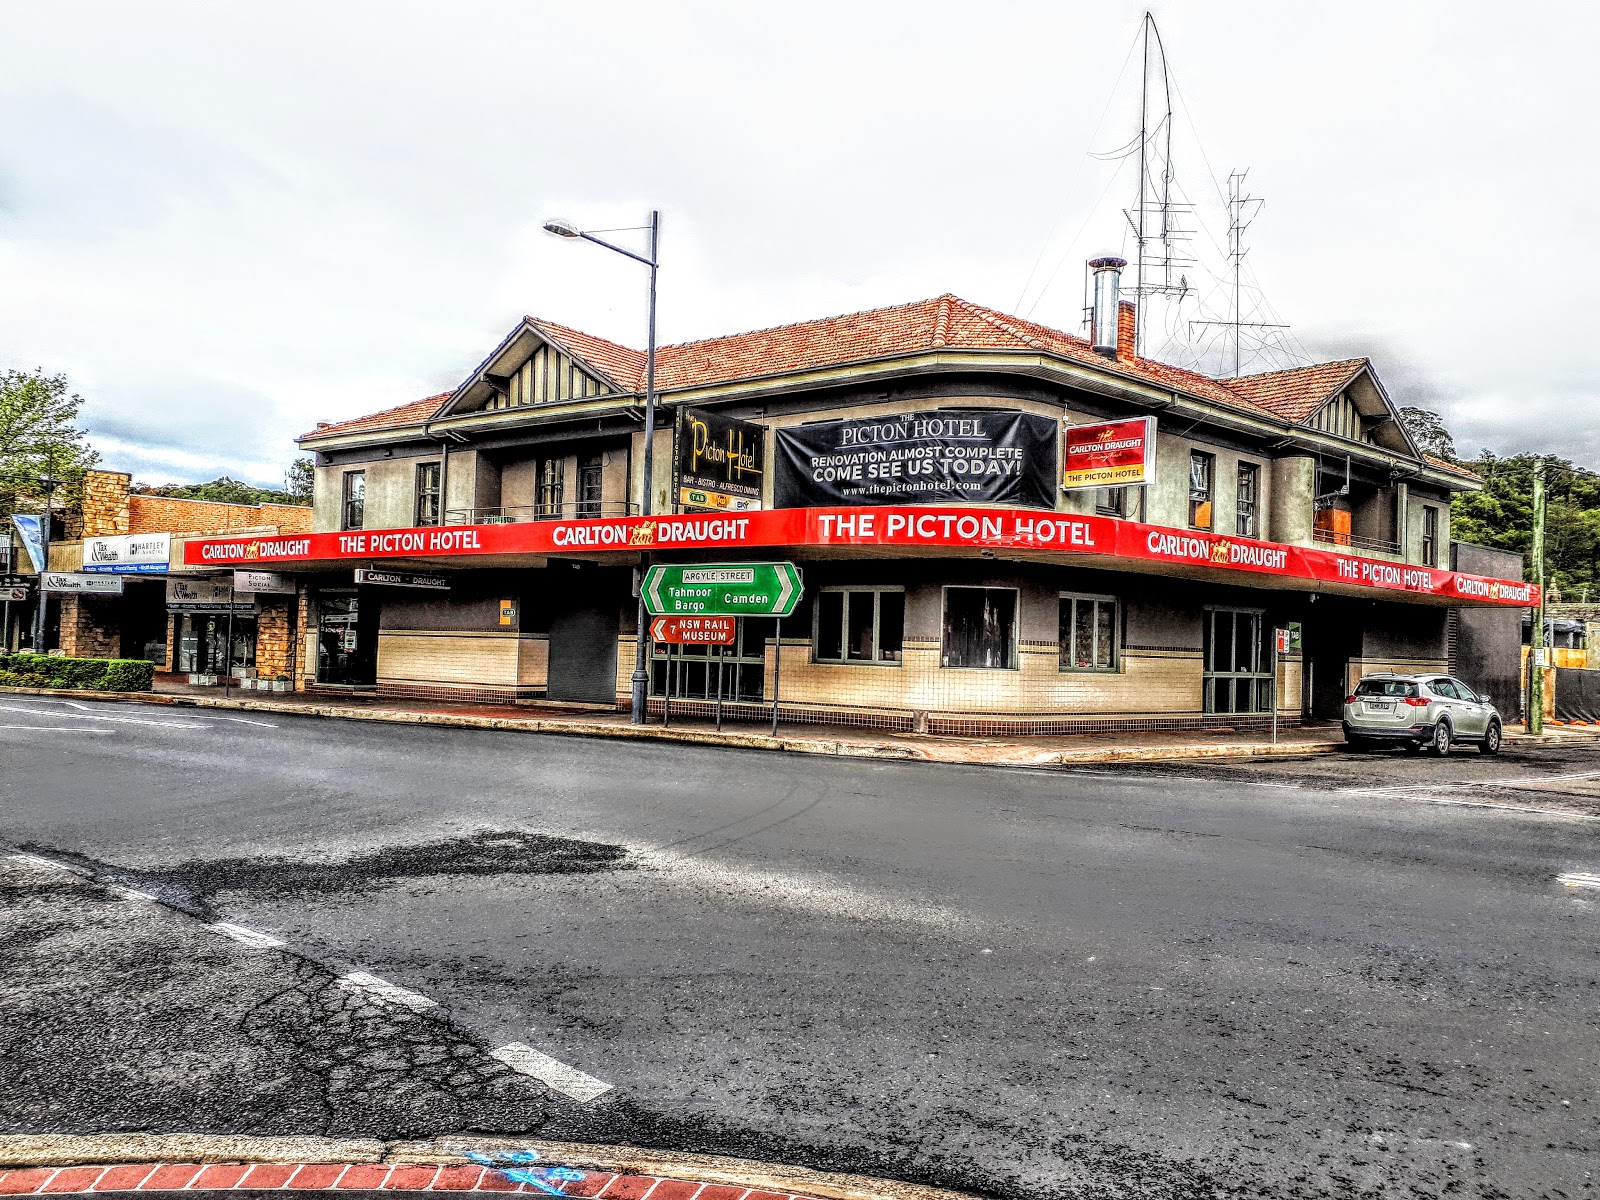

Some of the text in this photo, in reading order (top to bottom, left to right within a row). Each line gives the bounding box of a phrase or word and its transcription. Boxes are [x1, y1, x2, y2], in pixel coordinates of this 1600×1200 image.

[841, 419, 986, 445] PICTON HOTEL
[692, 418, 755, 480] Picton Hotel
[1069, 439, 1142, 454] CARLTON DRAUGHT
[811, 447, 1023, 467] RENOVATION ALMOST COMPLETE
[813, 458, 1021, 482] COME SEE US TODAY!
[1085, 472, 1112, 480] PICTON
[1115, 469, 1140, 478] HOTEL
[683, 475, 694, 484] BAR
[698, 478, 716, 488] BISTRO
[719, 482, 743, 492] ALFRESCO
[743, 486, 760, 495] DINING
[843, 480, 981, 495] www.thepictonhotel.com
[552, 519, 749, 546] CARLTON DRAUGHT
[818, 514, 1095, 546] THE PICTON HOTEL
[96, 541, 107, 551] Tax
[202, 539, 310, 559] CARLTON DRAUGHT
[338, 530, 481, 553] THE PICTON HOTEL
[98, 551, 118, 561] Wealth
[1147, 531, 1287, 569] CARLTON DRAUGHT
[367, 573, 401, 583] CARLTON
[413, 577, 446, 586] DRAUGHT
[684, 571, 751, 581] ARGYLE STREET
[1337, 558, 1434, 589] THE PICTON HOTEL
[177, 582, 187, 591] Tax
[668, 587, 712, 597] Tahmoor
[1457, 577, 1531, 601] CARLTON DRAUGHT
[724, 593, 768, 604] Camden
[675, 600, 705, 613] Bargo
[670, 625, 676, 634] 7
[679, 619, 730, 629] NSW RAIL
[682, 632, 726, 641] MUSEUM
